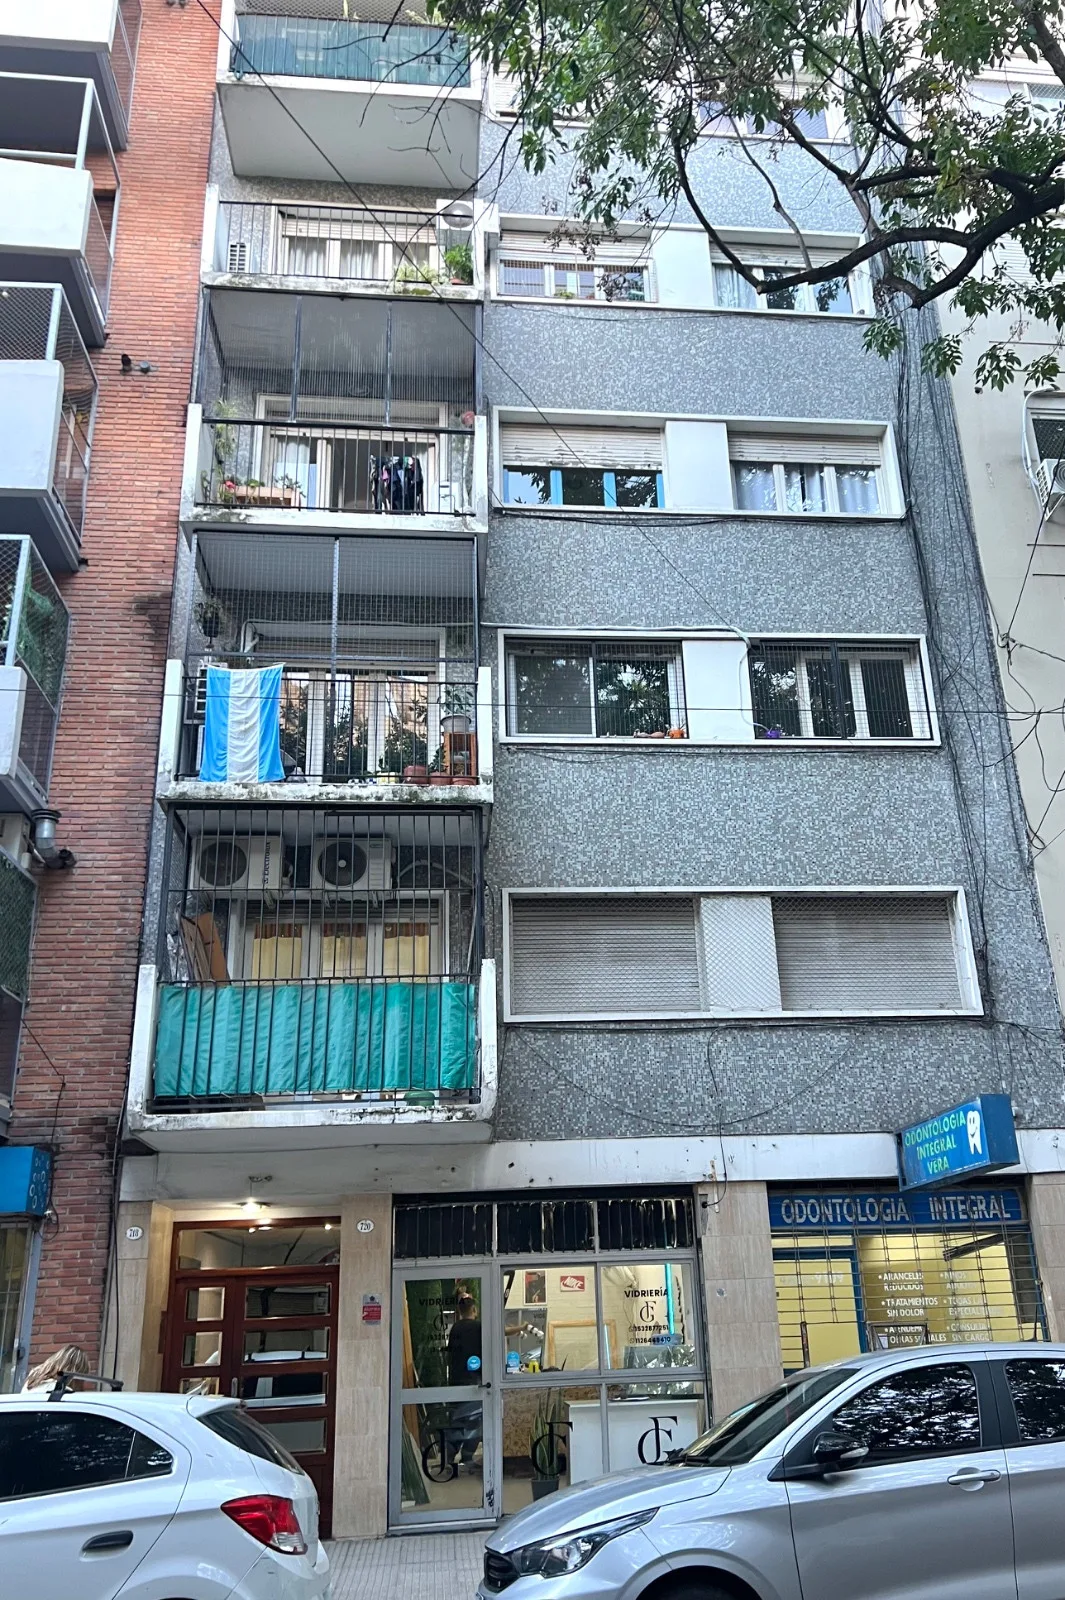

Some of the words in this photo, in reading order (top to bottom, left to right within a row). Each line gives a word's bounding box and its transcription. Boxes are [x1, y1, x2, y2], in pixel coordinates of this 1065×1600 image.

[904, 1110, 967, 1146] ODONTOLOGIA
[916, 1134, 957, 1160] INTEGRAL
[927, 1156, 950, 1175] VERA
[781, 1197, 911, 1223] ODONTOLOGIA
[928, 1195, 1012, 1221] INTEGRAL
